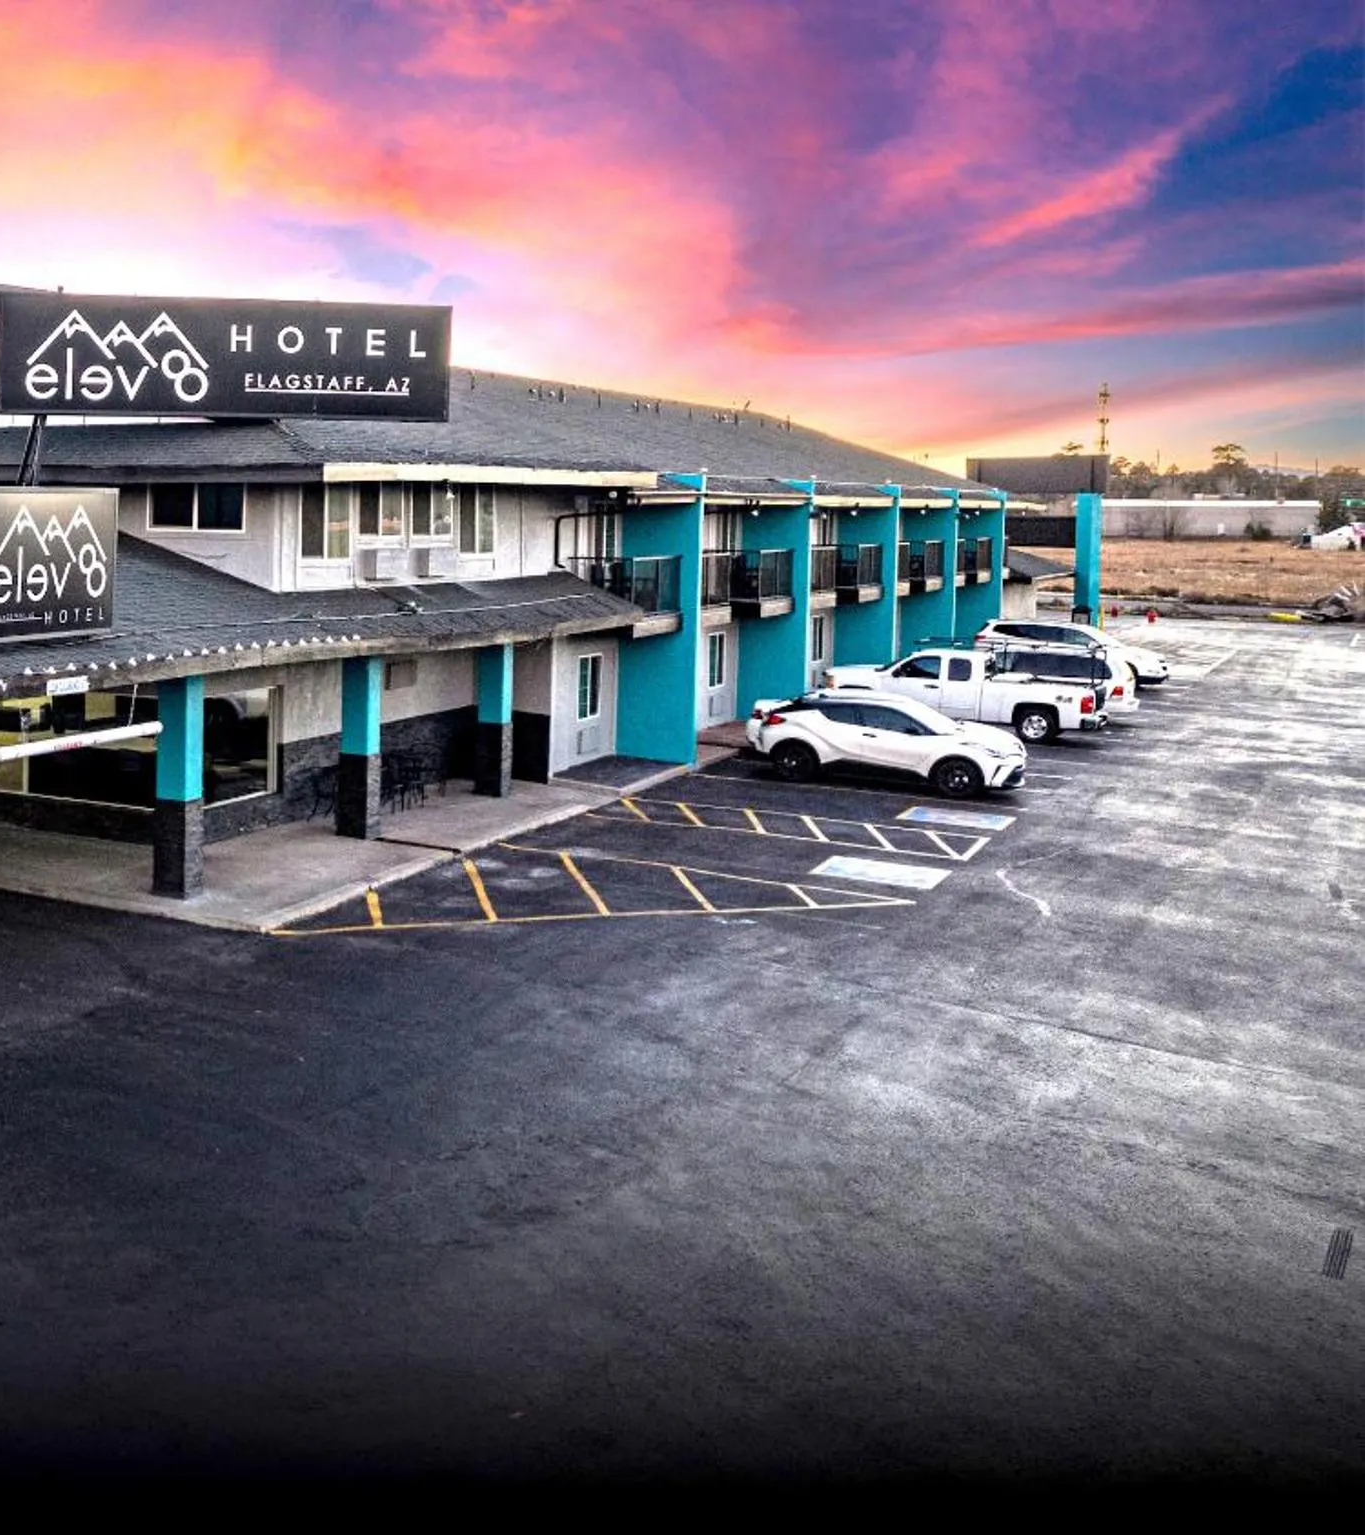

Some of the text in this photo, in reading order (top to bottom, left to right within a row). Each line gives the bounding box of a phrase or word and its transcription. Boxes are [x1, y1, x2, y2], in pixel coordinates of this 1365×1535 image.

[230, 324, 427, 358] HOTEL
[244, 373, 410, 393] FLAGSTAFF, AZ
[44, 607, 105, 625] HOTEL
